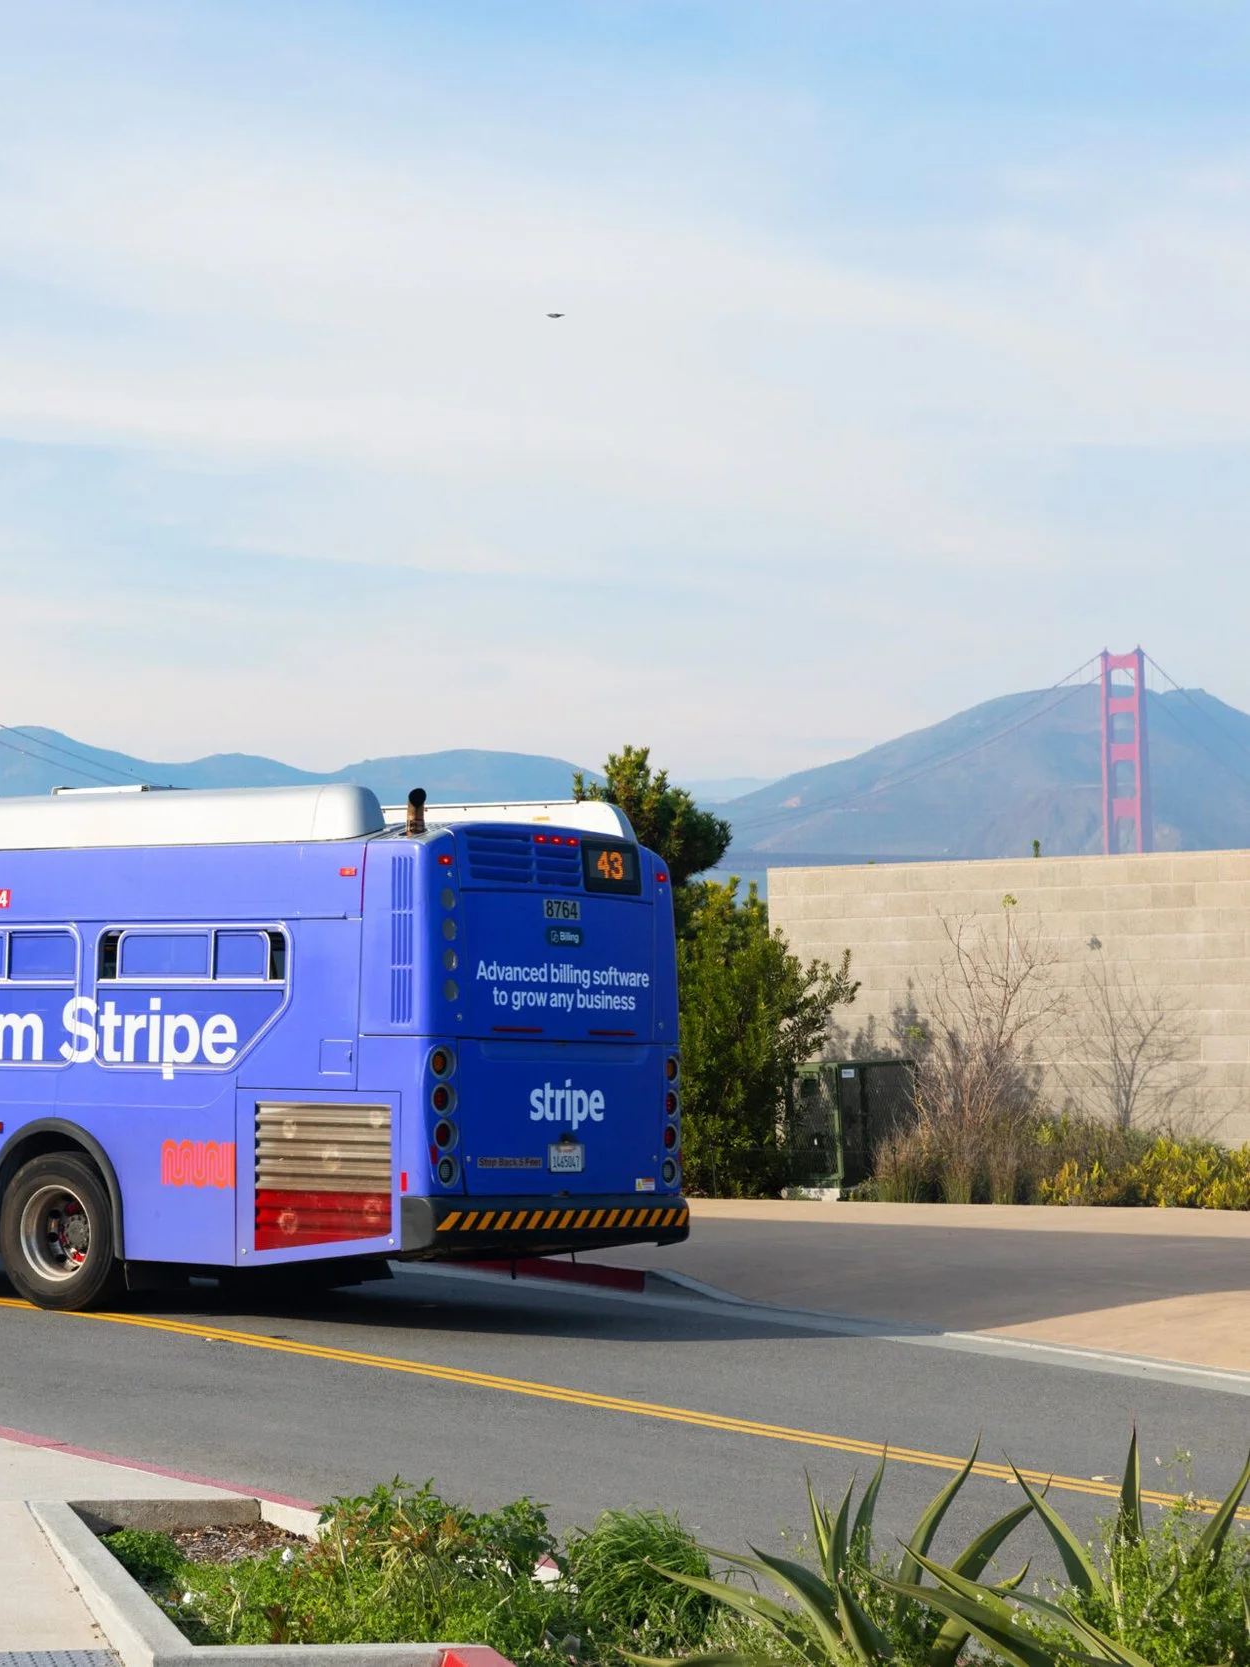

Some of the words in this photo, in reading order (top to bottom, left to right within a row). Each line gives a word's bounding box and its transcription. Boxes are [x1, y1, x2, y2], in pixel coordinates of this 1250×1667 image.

[597, 851, 625, 880] 43
[546, 901, 578, 918] 8764
[560, 931, 580, 943] Billing
[476, 960, 548, 982] Advanced
[551, 963, 591, 989] billing
[592, 966, 650, 988] software
[493, 987, 508, 1006] to
[512, 989, 547, 1011] grow
[550, 992, 574, 1013] any
[577, 989, 636, 1011] business
[58, 996, 238, 1080] Stripe
[530, 1079, 605, 1131] stripe
